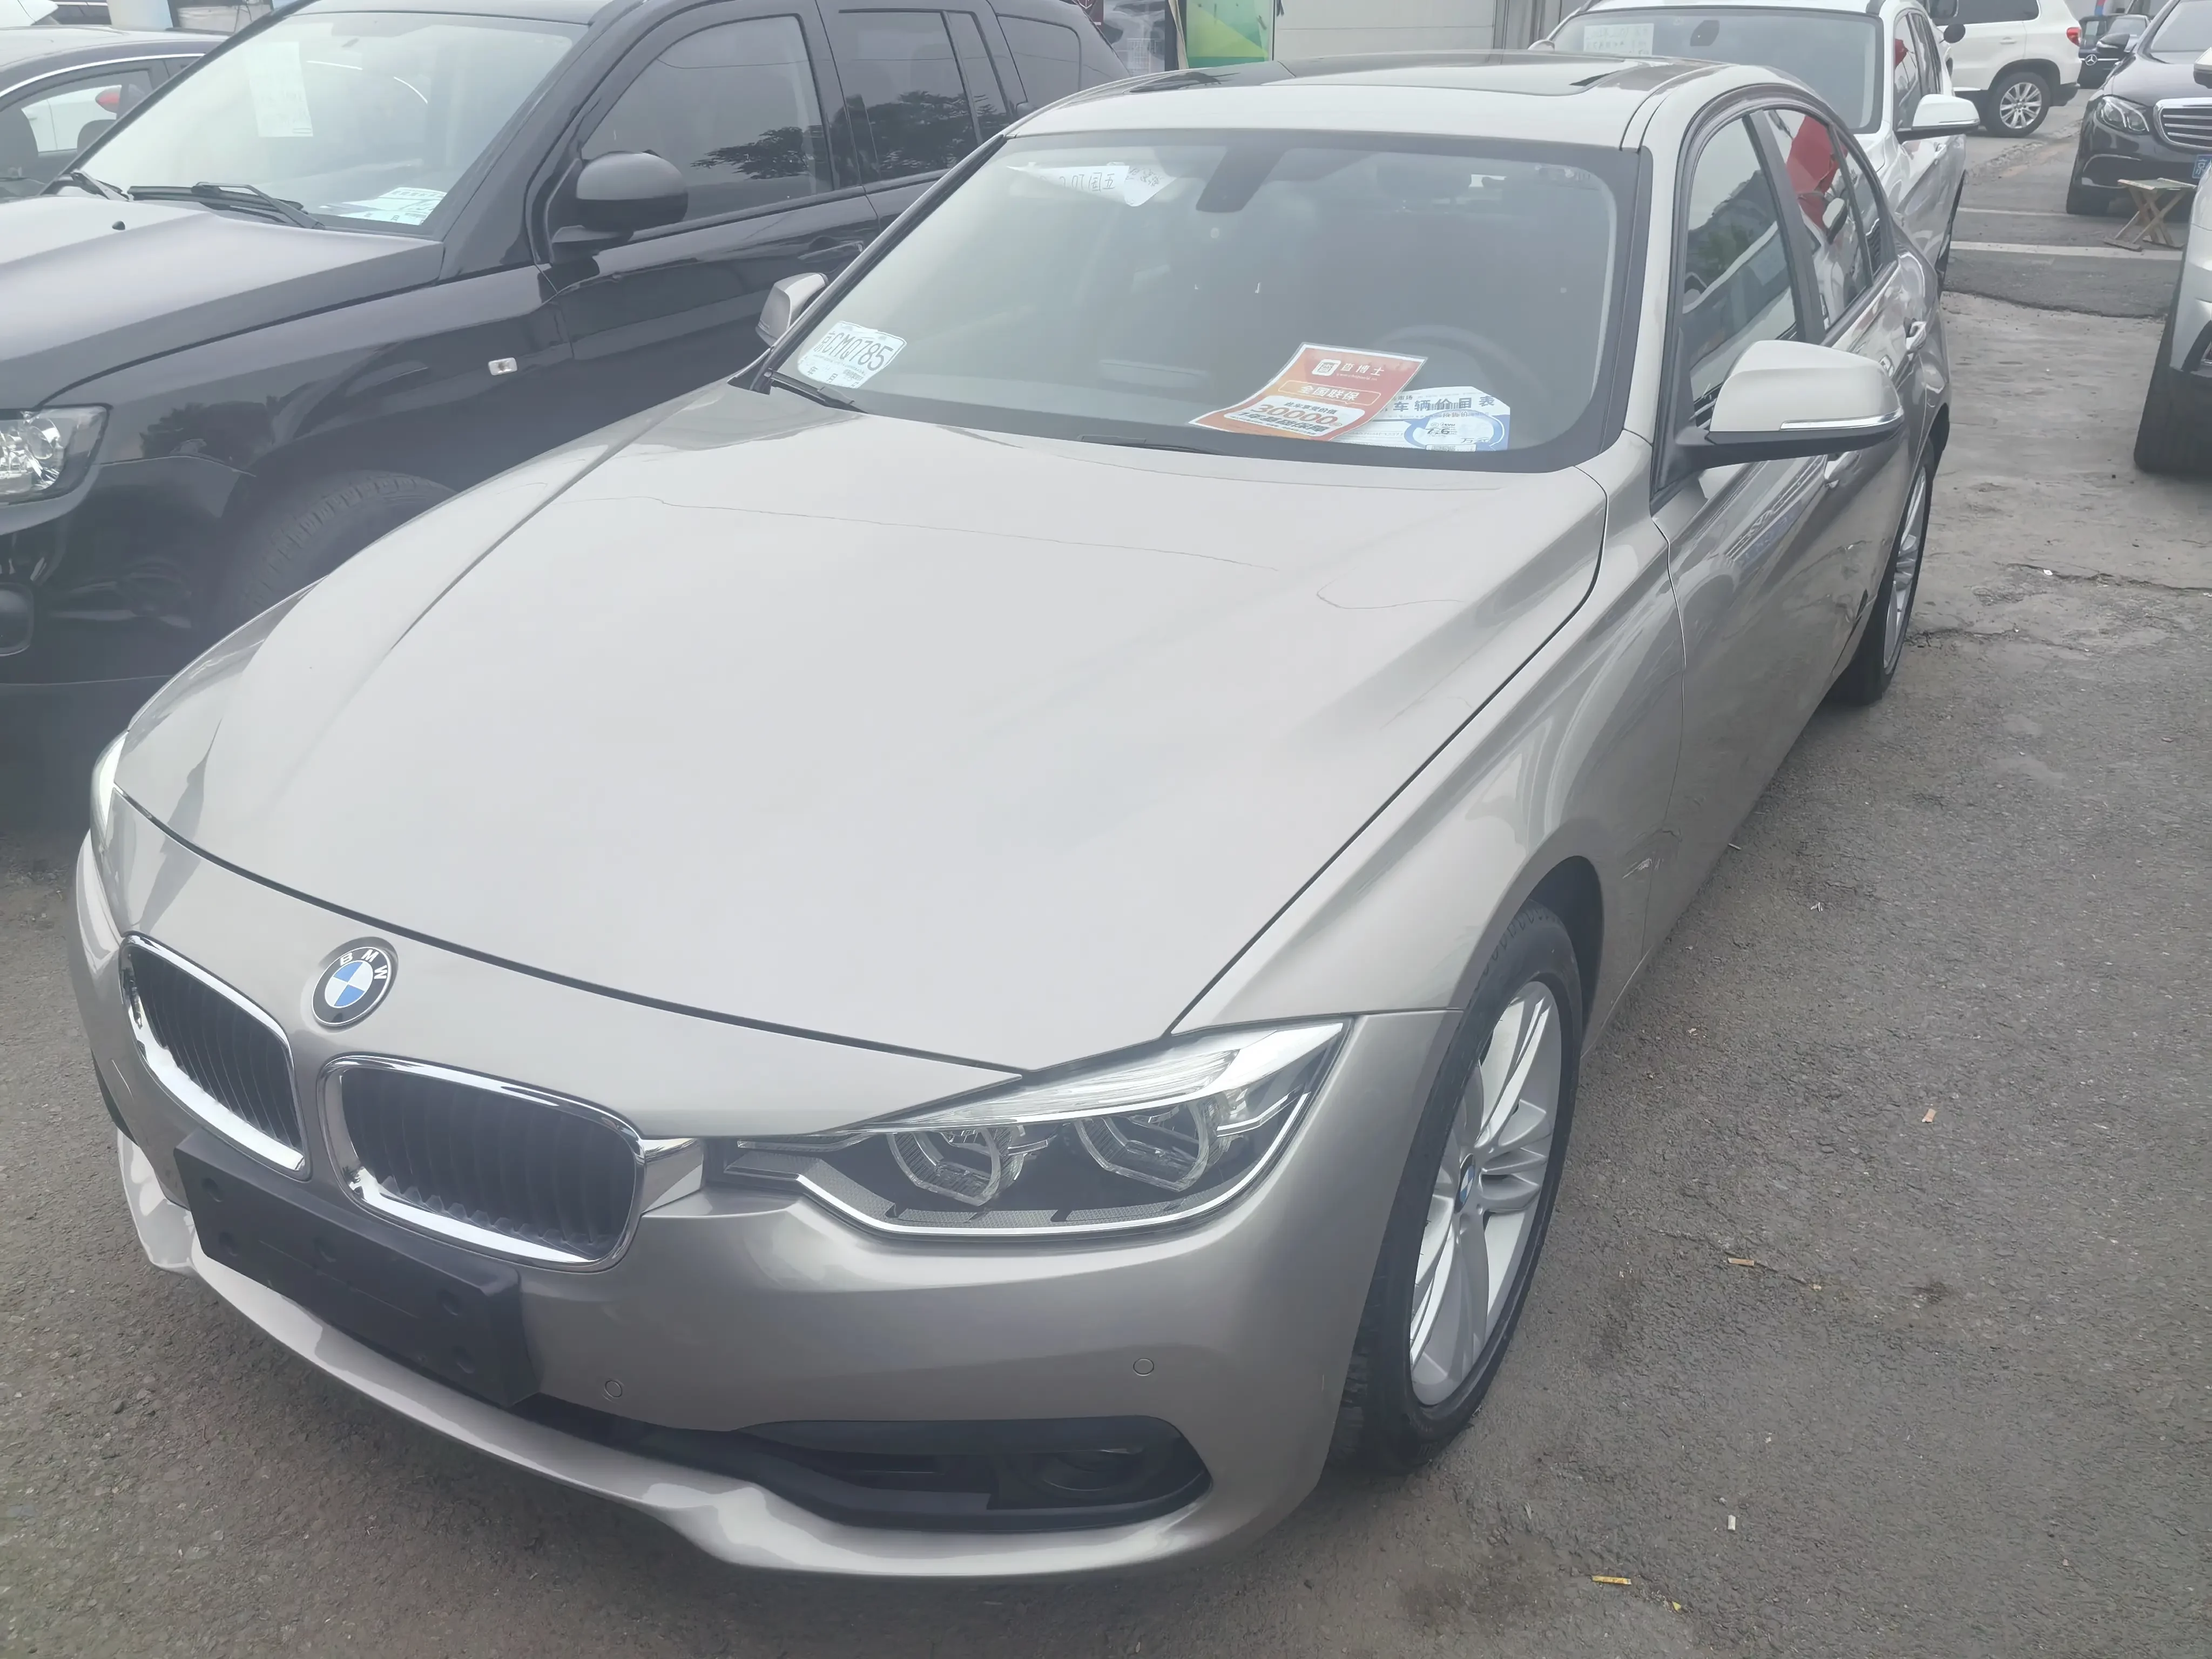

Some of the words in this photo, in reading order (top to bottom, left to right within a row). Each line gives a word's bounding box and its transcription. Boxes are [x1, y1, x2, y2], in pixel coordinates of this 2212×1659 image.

[1340, 363, 1384, 376] 查博士
[1297, 385, 1360, 401] 全国联保
[1284, 401, 1338, 415] 此车享受价值
[1393, 395, 1495, 412] 车辆价目表
[1252, 404, 1339, 424] 30000
[339, 949, 388, 980] BMW
